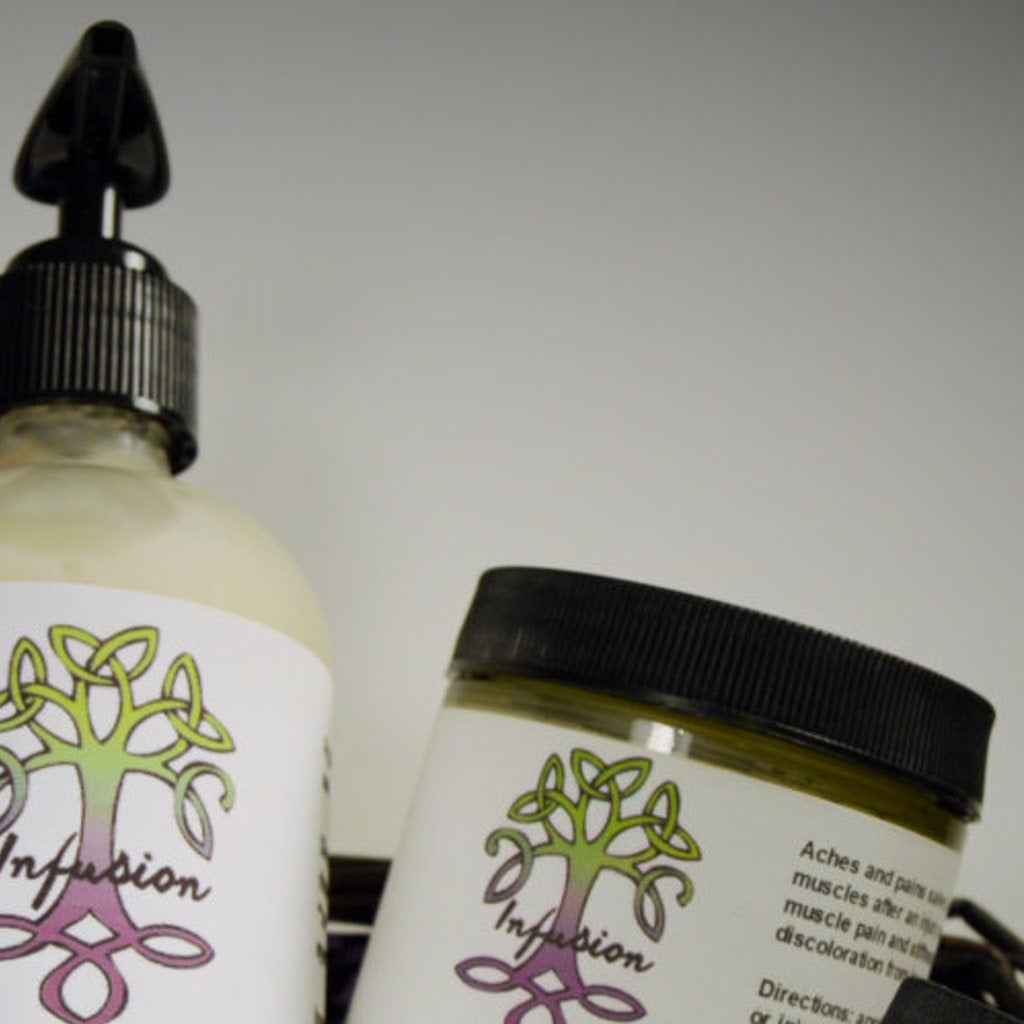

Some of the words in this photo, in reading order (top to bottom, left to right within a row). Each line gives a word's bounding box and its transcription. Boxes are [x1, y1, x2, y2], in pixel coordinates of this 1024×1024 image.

[798, 839, 861, 875] Aches
[863, 863, 895, 887] and
[791, 869, 870, 909] muscles
[492, 898, 656, 977] Infusion
[782, 897, 853, 934] muscle
[852, 921, 888, 946] pain
[774, 924, 885, 975] discoloration
[757, 977, 854, 1024] Directions:
